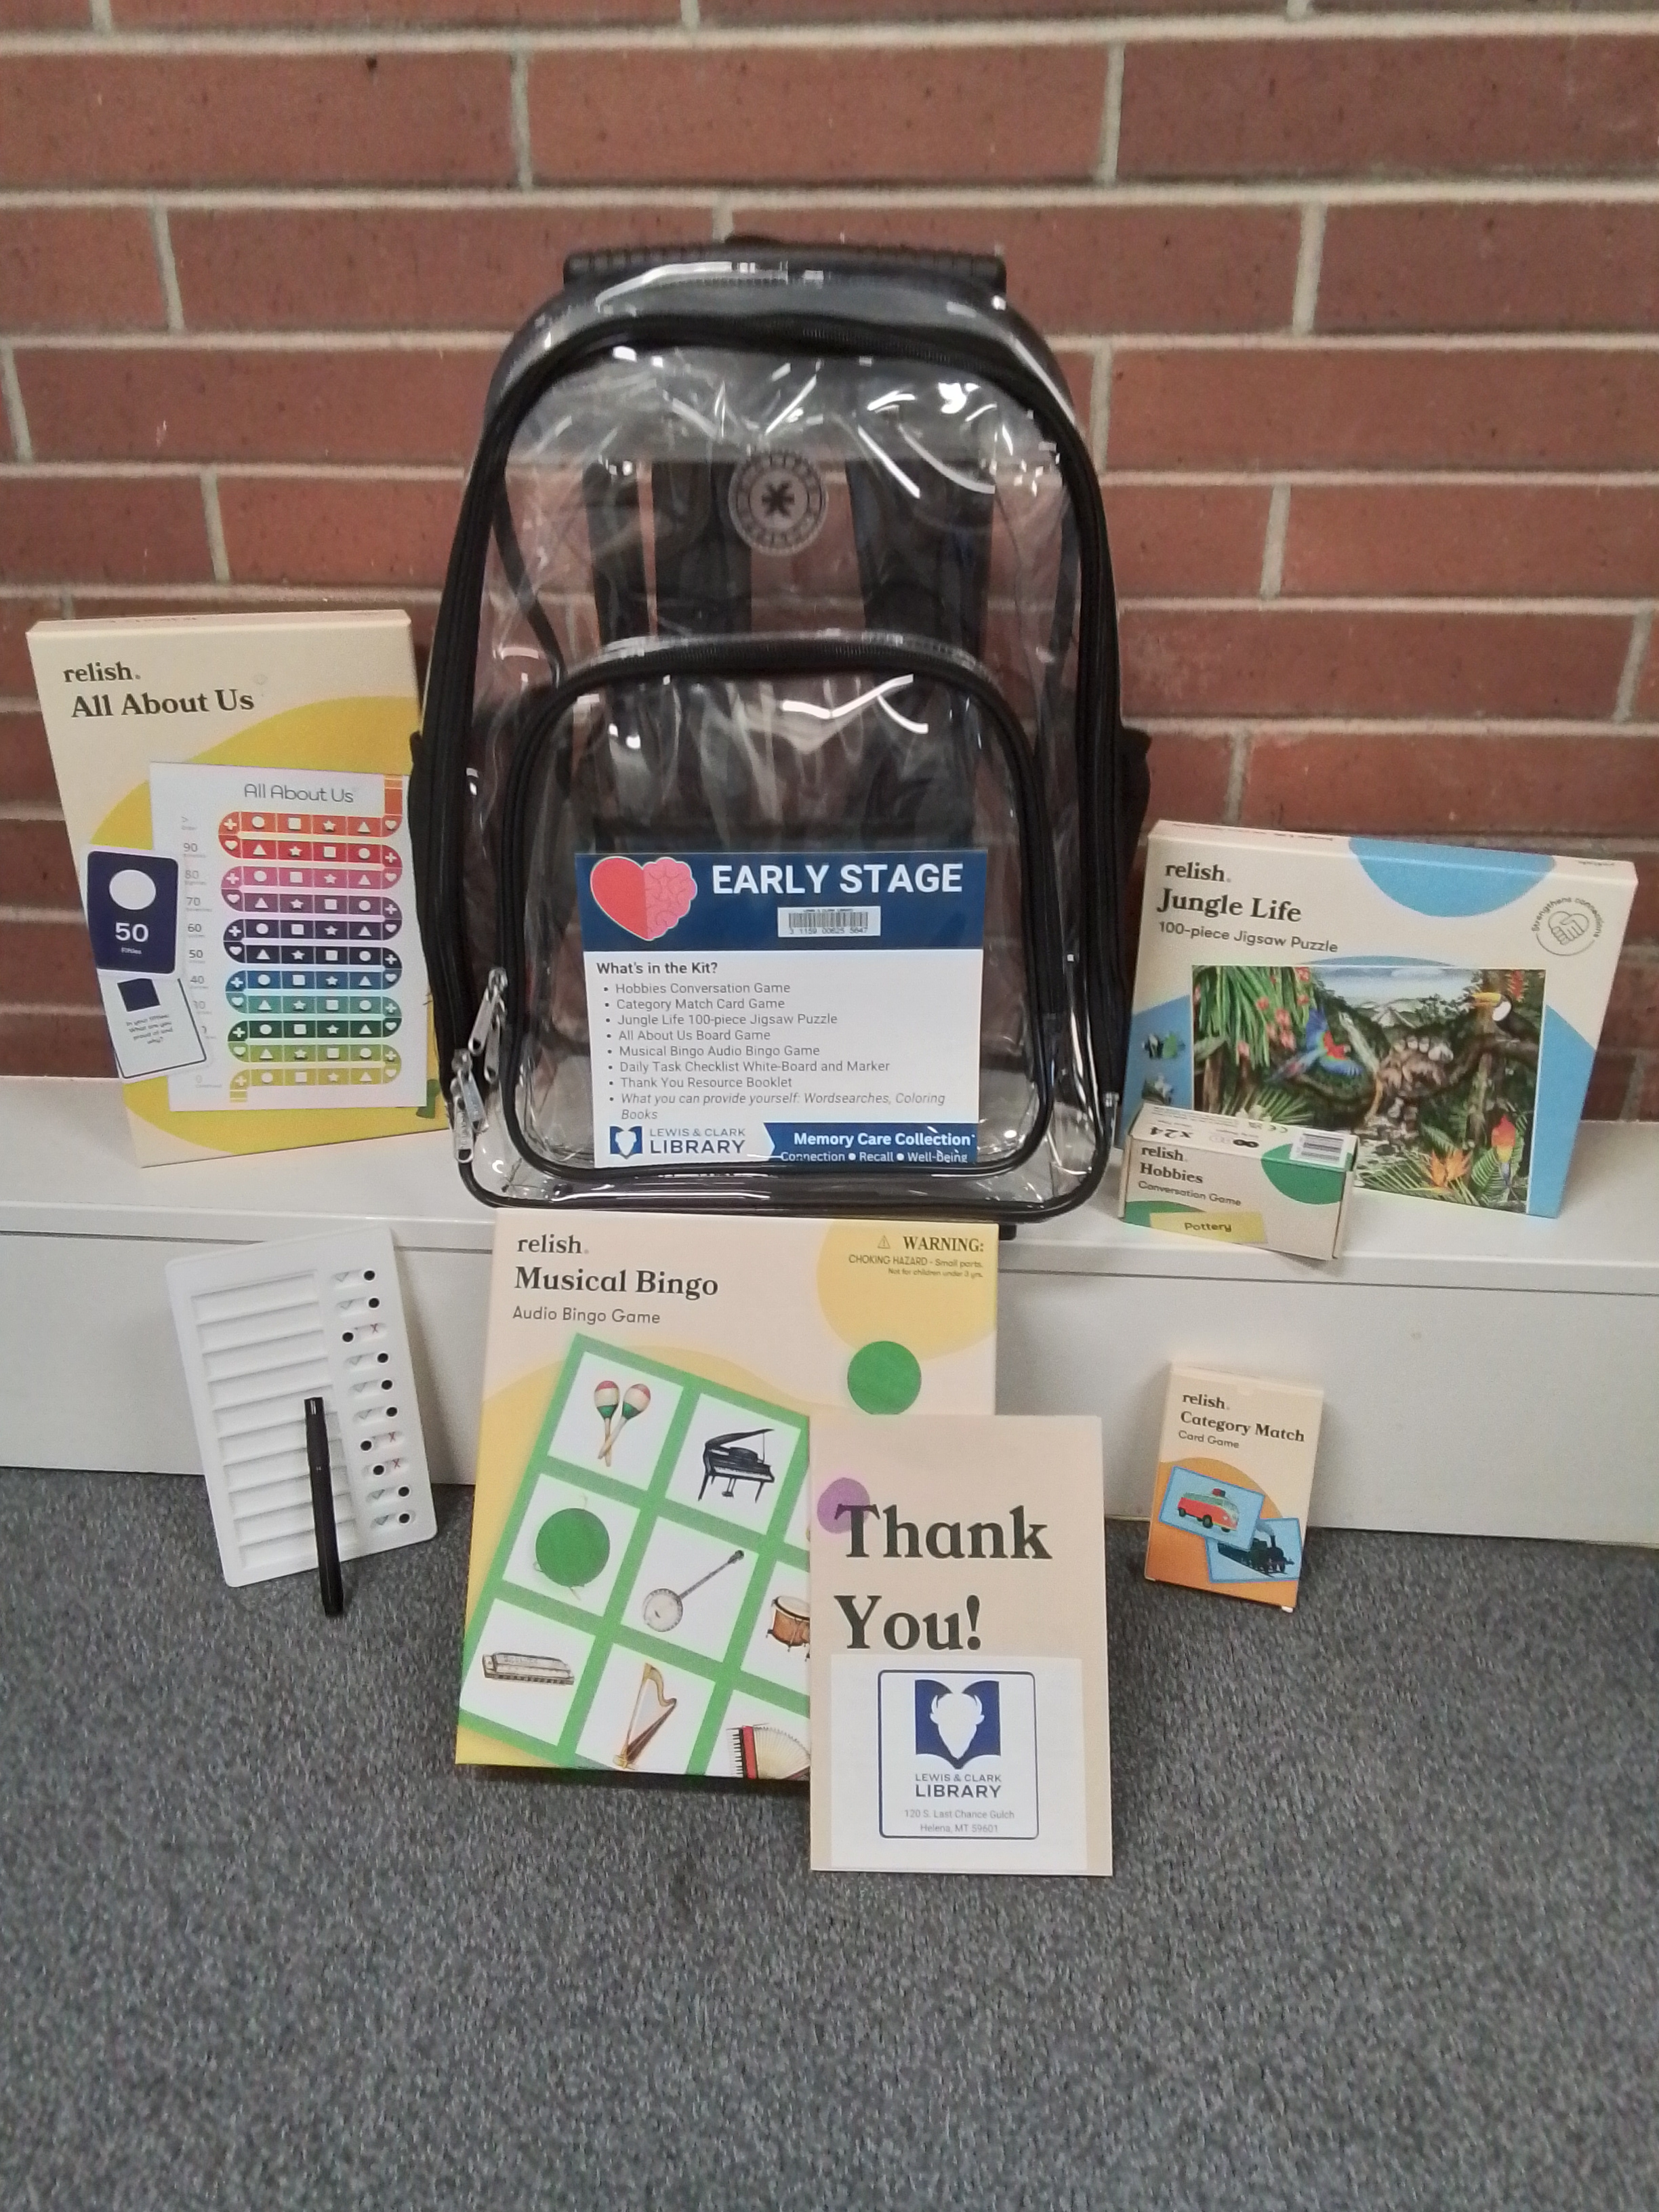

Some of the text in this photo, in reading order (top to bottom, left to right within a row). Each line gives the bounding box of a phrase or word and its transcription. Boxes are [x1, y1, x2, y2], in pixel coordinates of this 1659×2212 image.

[71, 689, 255, 718] All About Us
[244, 783, 354, 802] All About Us
[183, 842, 198, 853] 90
[184, 869, 199, 880] 80
[712, 863, 964, 895] EARLY STAGE
[186, 897, 201, 906] 70
[1156, 888, 1302, 922] Jungle Life
[115, 922, 149, 942] 50
[188, 923, 202, 933] 60
[1159, 920, 1338, 953] 100-piece Jigsaw Puzzle
[189, 949, 203, 959] 50
[596, 961, 718, 974] What's in the Kit?
[190, 975, 205, 984] 40
[615, 983, 791, 994] Hobbies Conversation Game
[617, 998, 785, 1011] Category Match Card Game
[617, 1013, 838, 1027] Jungle Life 100-piece Jigsaw Puzzle
[619, 1029, 771, 1041] All About Us Board Game
[619, 1045, 820, 1058] Musical Bingo Audio Bingo Game
[620, 1061, 890, 1074] Daily Task Checklist White-Board and Marker
[621, 1076, 792, 1088] Thank You Resource Booklet
[621, 1092, 945, 1106] What you can provide yourself: Wordsearches, Coloring
[621, 1109, 658, 1119] Books
[650, 1128, 745, 1136] LEWIS & CLARK
[651, 1139, 745, 1153] LIBRARY
[794, 1132, 971, 1148] Memory Care Collection
[781, 1151, 845, 1162] Connection
[859, 1151, 894, 1162] Recall
[1140, 1162, 1204, 1184] Hobbies
[1138, 1180, 1242, 1207] Conversation Game
[1184, 1222, 1232, 1233] Pottery
[903, 1236, 985, 1252] WARNING:
[848, 1254, 891, 1265] CHOKING
[893, 1256, 928, 1266] HAZARD
[935, 1258, 958, 1267] Small
[914, 1269, 941, 1277] children
[943, 1269, 963, 1277] under
[514, 1266, 718, 1300] Musical Bingo
[512, 1305, 661, 1325] Audio Bingo Game
[1180, 1410, 1305, 1443] Category Match
[1178, 1429, 1240, 1450] Card Game
[834, 1503, 1053, 1560] Thank
[833, 1594, 982, 1652] You!
[915, 1774, 1002, 1782] LEWIS & CLARK
[916, 1784, 1002, 1799] LIBRARY
[905, 1809, 920, 1818] 120
[934, 1810, 952, 1818] Last
[955, 1810, 987, 1819] Chance
[990, 1810, 1015, 1820] Gulch
[920, 1824, 999, 1834] Helena, MT 59601
